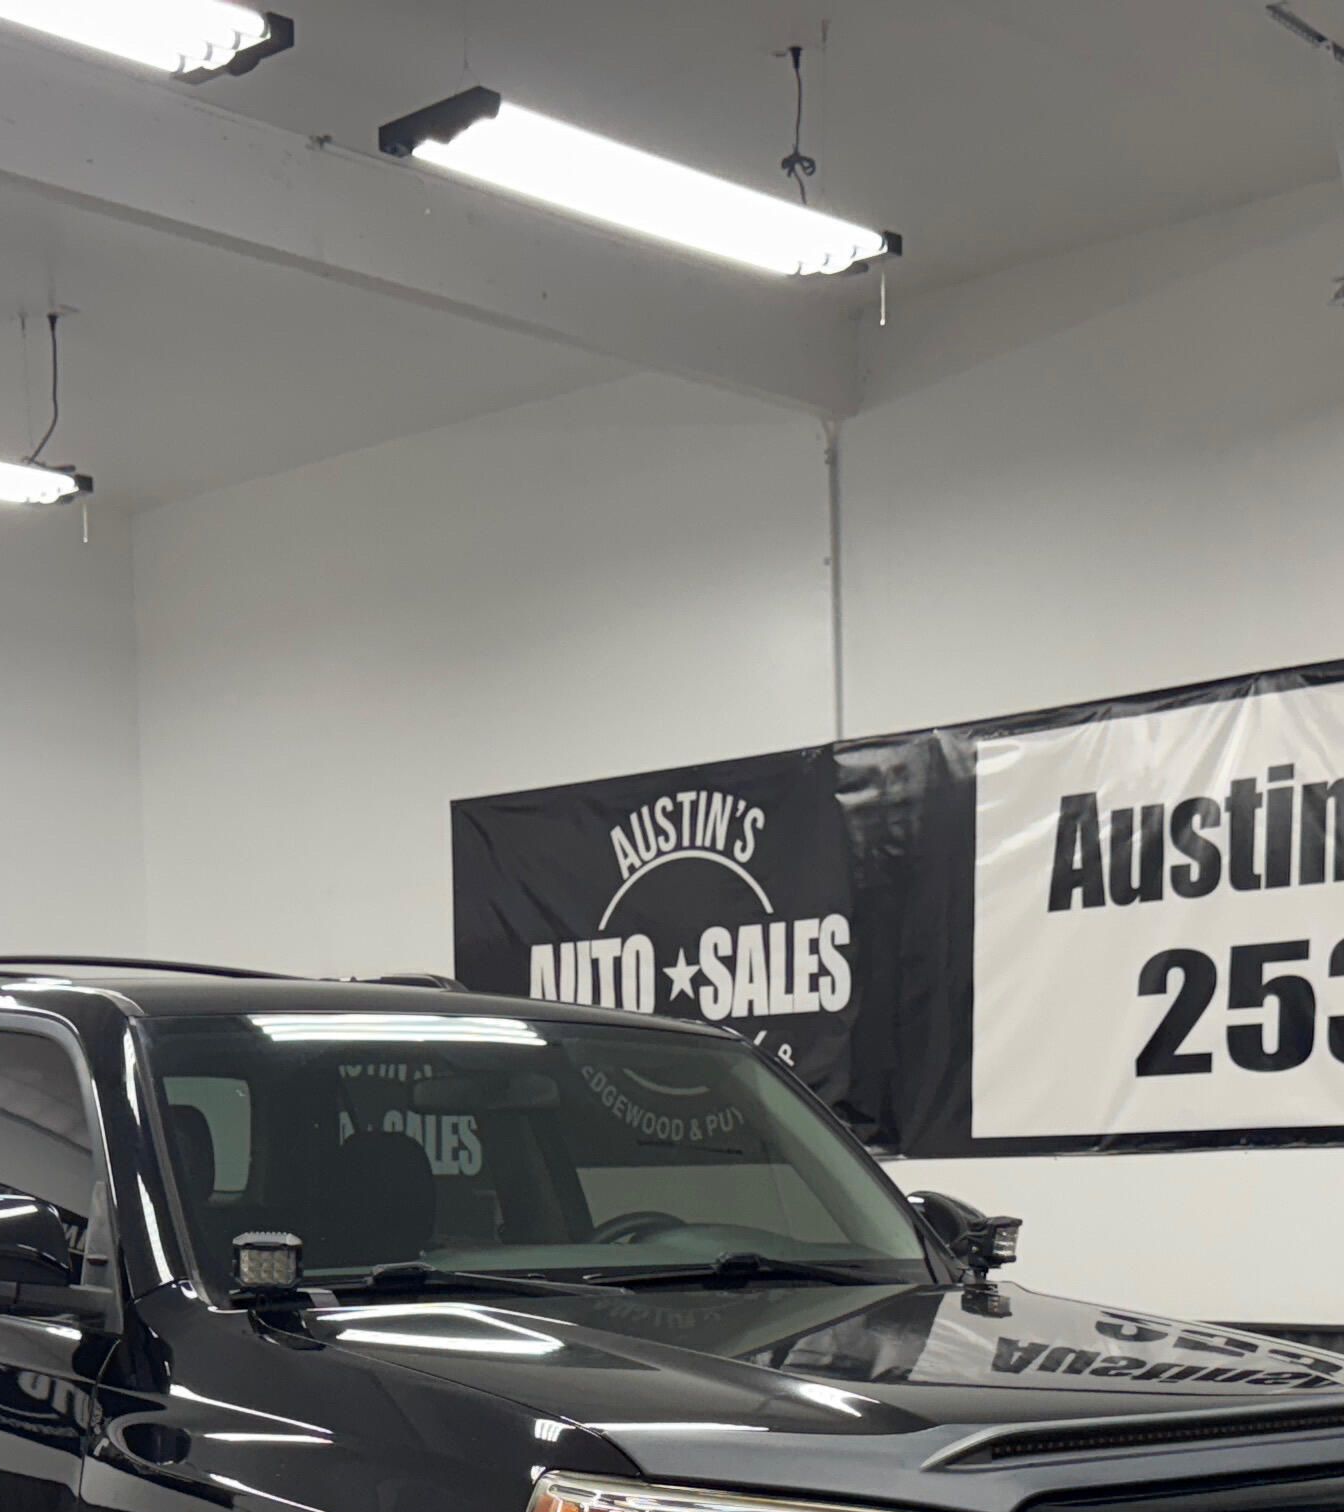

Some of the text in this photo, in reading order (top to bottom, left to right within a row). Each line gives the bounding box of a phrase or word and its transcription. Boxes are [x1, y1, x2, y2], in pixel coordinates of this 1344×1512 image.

[610, 790, 765, 880] AUSTIN'S
[529, 914, 852, 1022] AUTO SALES
